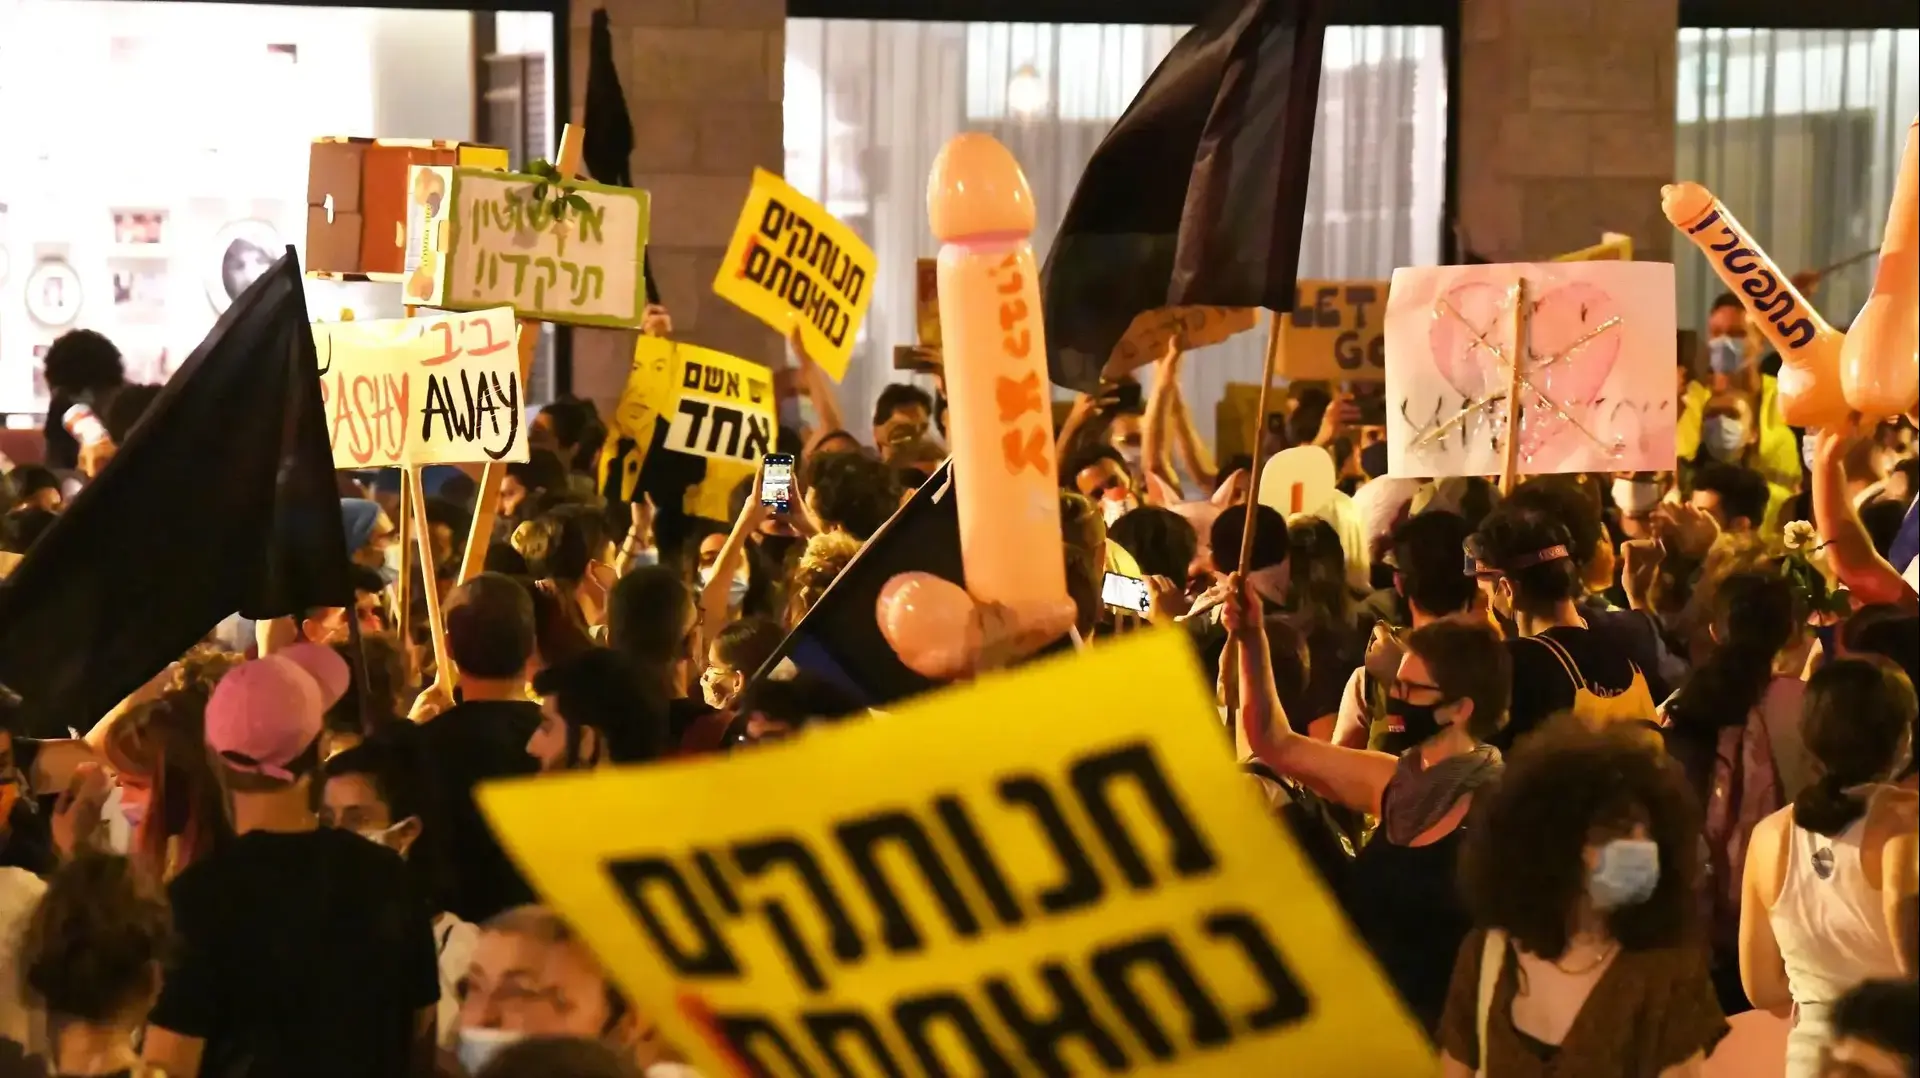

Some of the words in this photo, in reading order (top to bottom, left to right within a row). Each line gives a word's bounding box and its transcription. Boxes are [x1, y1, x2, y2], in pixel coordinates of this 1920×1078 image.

[472, 248, 604, 310] תרקדו!
[760, 197, 866, 307] מנותקים
[1293, 286, 1376, 328] LET
[419, 317, 511, 367] ביבי
[683, 361, 740, 398] אשם
[420, 368, 519, 460] AWAY
[678, 398, 770, 461] אחד
[600, 738, 1220, 994] מנותקים
